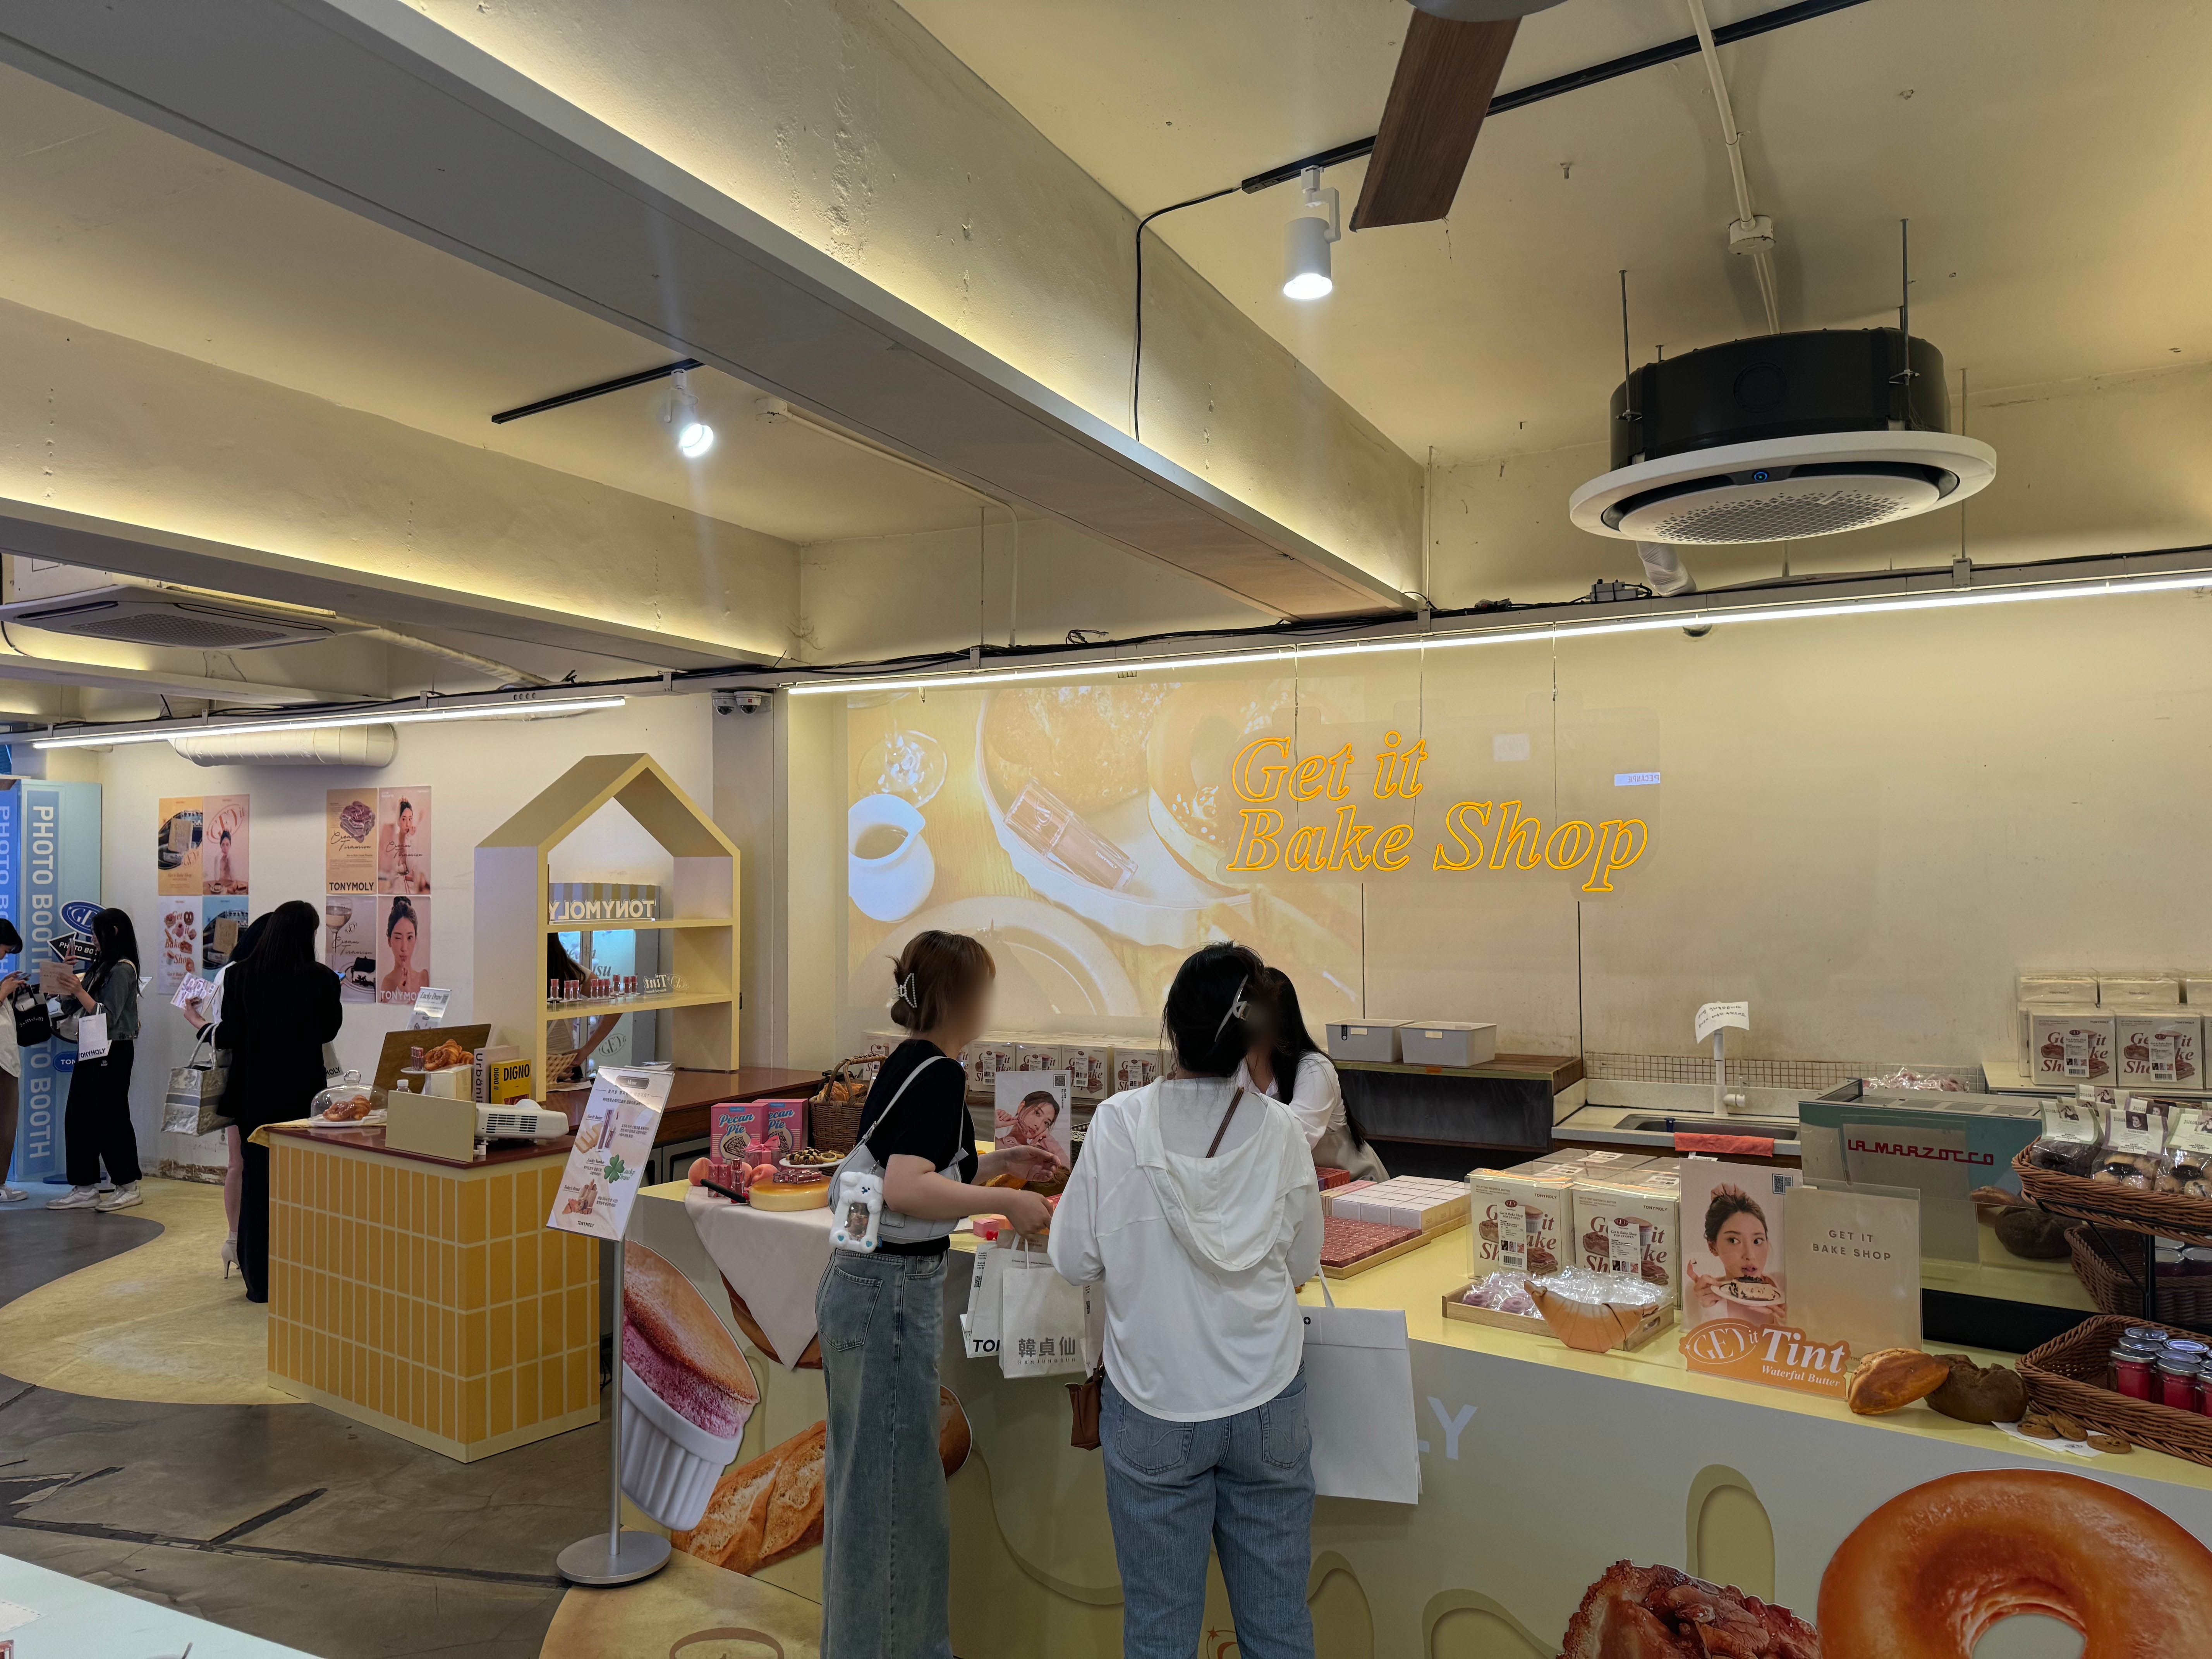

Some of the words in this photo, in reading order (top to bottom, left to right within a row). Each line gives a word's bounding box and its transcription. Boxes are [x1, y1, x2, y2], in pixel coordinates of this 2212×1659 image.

[1232, 737, 1354, 802] Get
[1373, 731, 1428, 799] it
[33, 806, 53, 884] PHOTO
[1226, 805, 1413, 871] Bake
[1433, 800, 1647, 892] Shop
[329, 882, 374, 891] TONYMOLY
[59, 942, 82, 952] PHTO
[381, 991, 417, 1001] TONYMO
[2096, 1034, 2107, 1046] it
[2181, 1035, 2192, 1047] it
[1004, 1054, 1010, 1064] it
[1050, 1058, 1056, 1066] it
[1096, 1060, 1102, 1069] it
[326, 1066, 340, 1076] MOLY
[503, 1063, 530, 1081] DIGNO
[996, 1063, 1011, 1072] ake
[1149, 1063, 1155, 1072] it
[1088, 1070, 1103, 1079] ake
[29, 1077, 51, 1158] BOOTH
[719, 1114, 755, 1127] Pecan
[769, 1109, 795, 1120] ecan
[726, 1124, 745, 1136] Pie
[1848, 1139, 1866, 1151] LA
[1875, 1142, 1994, 1166] MARZOCCO
[1542, 1214, 1555, 1231] it
[1527, 1231, 1557, 1250] ake
[1651, 1226, 1665, 1244] it
[1829, 1230, 1854, 1240] GET
[1862, 1233, 1874, 1242] IT
[1813, 1243, 1846, 1255] BAKE
[1853, 1249, 1891, 1261] SHOP
[1018, 1336, 1075, 1357] 韓貞仙
[1693, 1328, 1745, 1360] GET
[1748, 1329, 1759, 1344] it
[1760, 1328, 1845, 1373] Tint
[1762, 1365, 1805, 1381] Waterful
[1807, 1373, 1840, 1387] Butter
